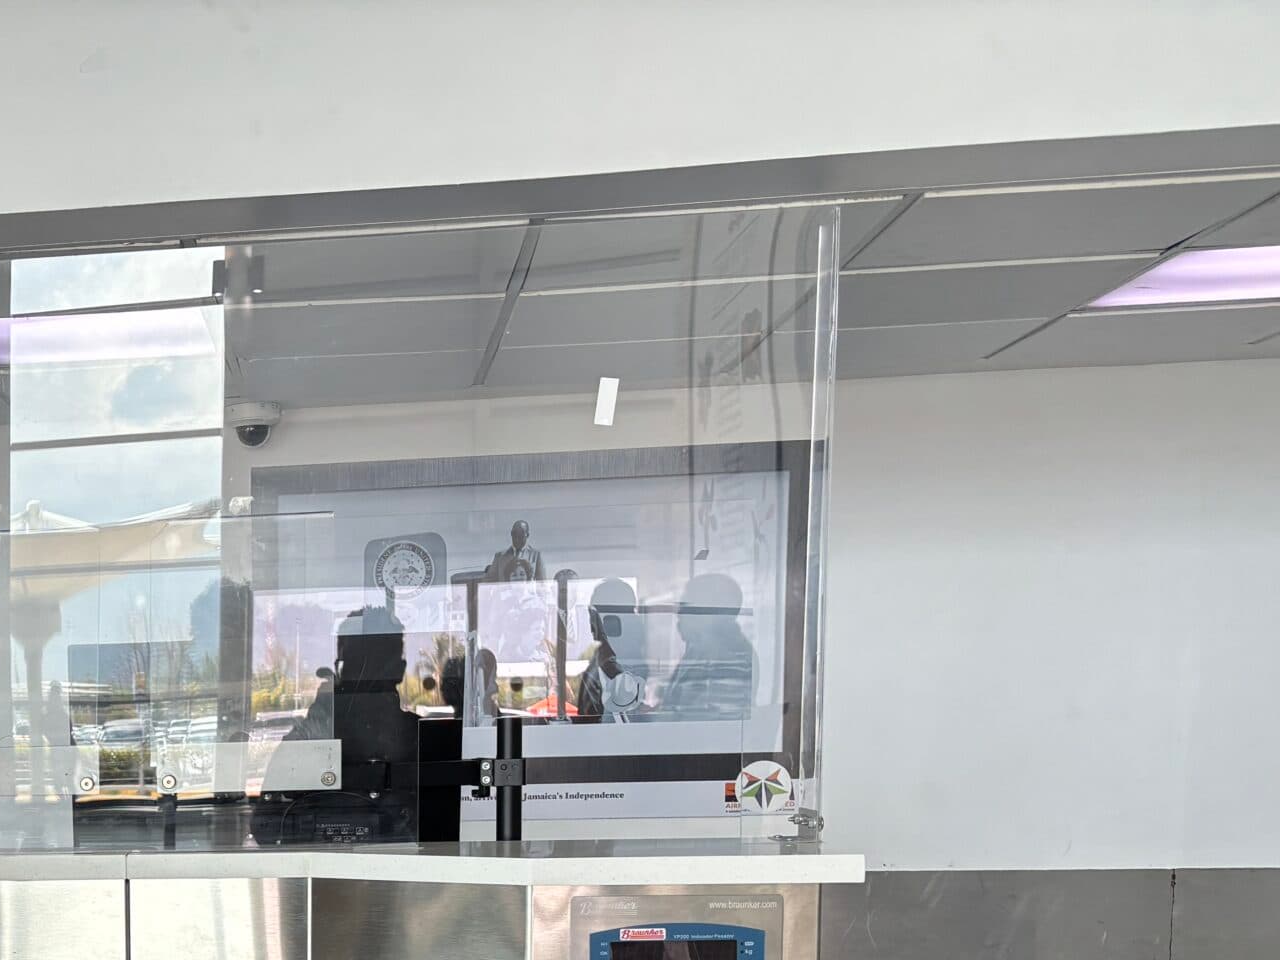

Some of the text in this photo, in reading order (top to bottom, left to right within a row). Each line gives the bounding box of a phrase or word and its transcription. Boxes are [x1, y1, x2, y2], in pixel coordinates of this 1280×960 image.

[523, 791, 625, 802] Jamaica's Independence
[709, 901, 777, 909] www.braunker.com
